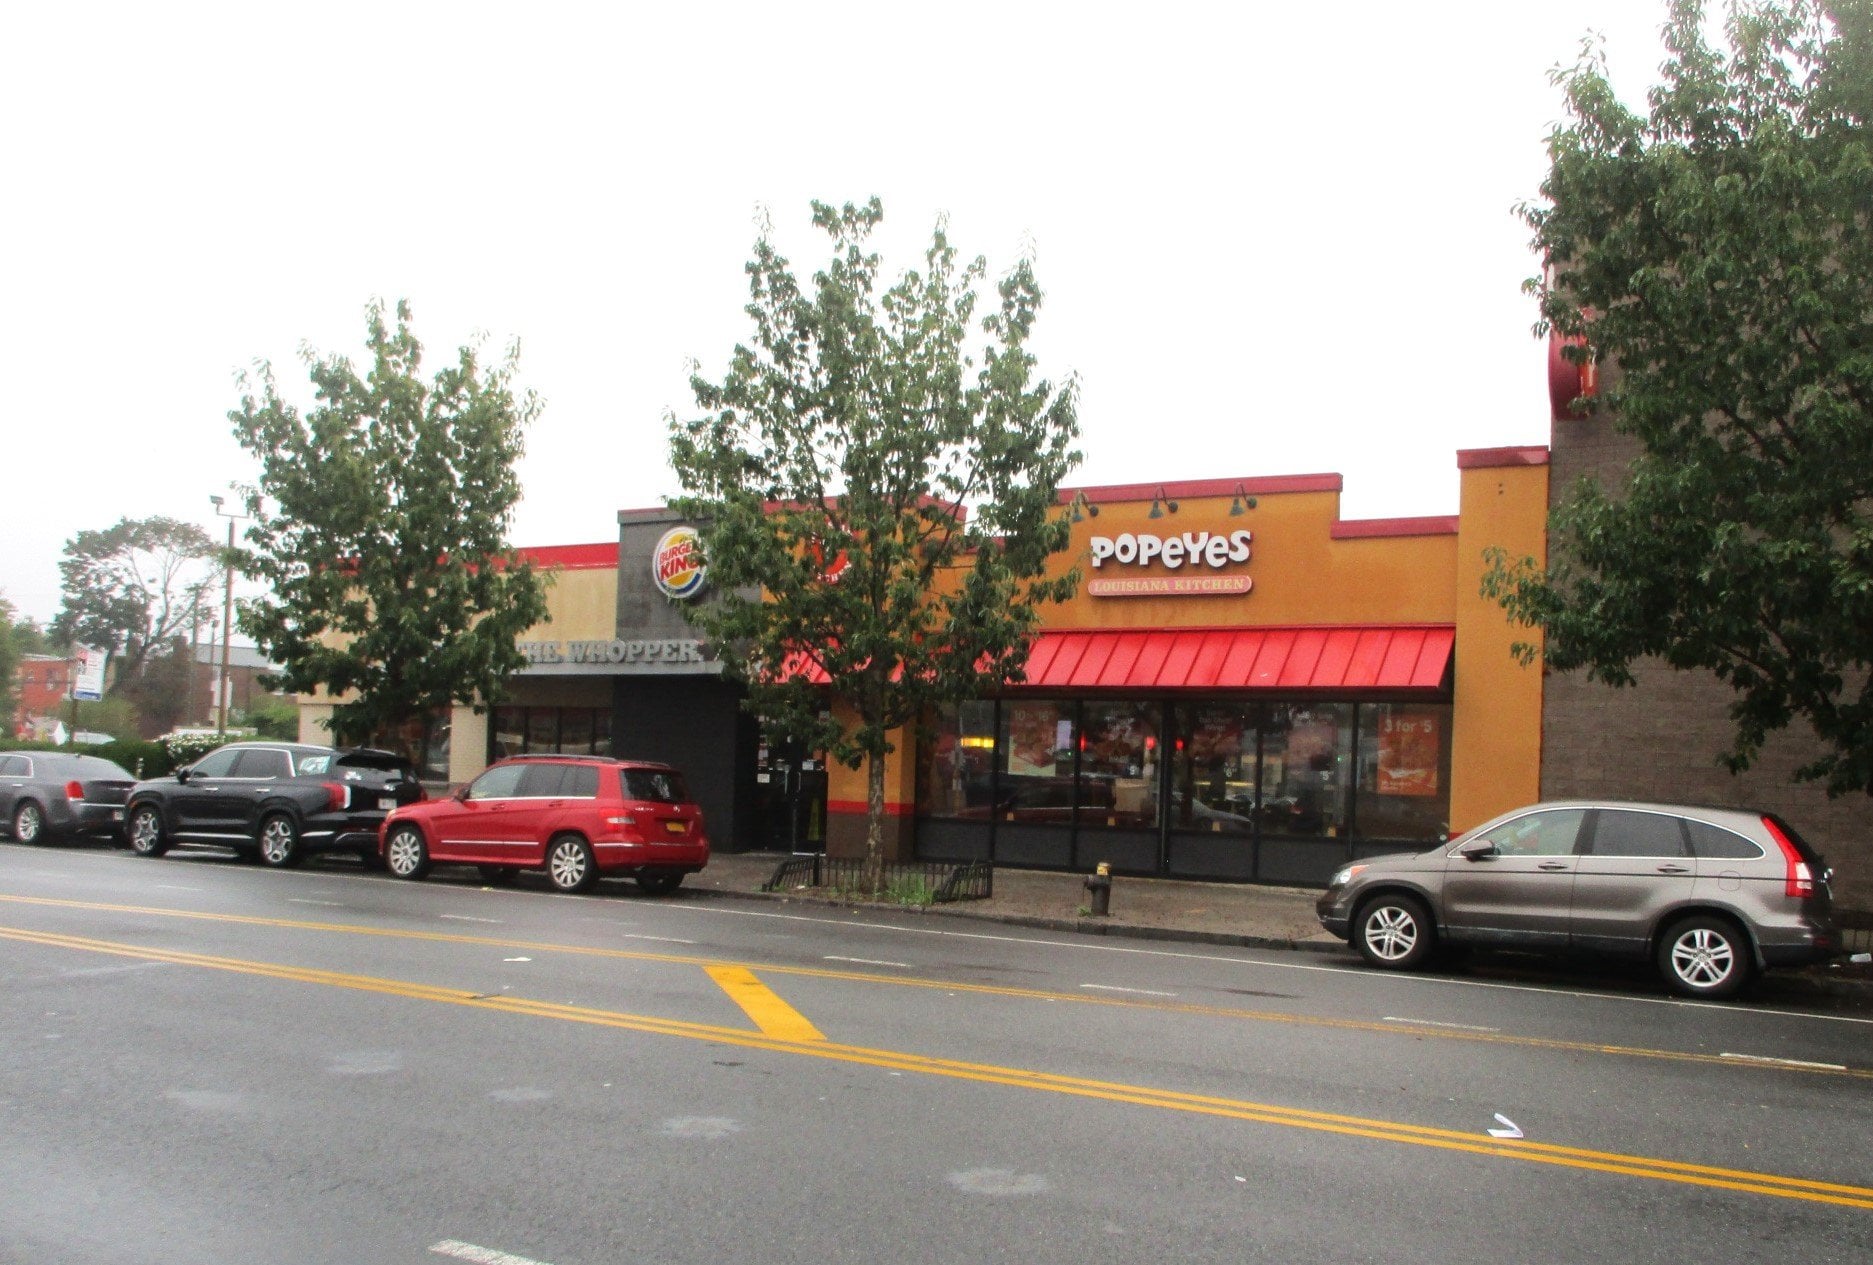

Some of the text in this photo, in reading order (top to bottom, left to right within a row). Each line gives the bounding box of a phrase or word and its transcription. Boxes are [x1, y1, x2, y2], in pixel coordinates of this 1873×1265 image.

[660, 541, 693, 564] BURGE
[1095, 578, 1244, 592] LOUISIANA KITCHEN
